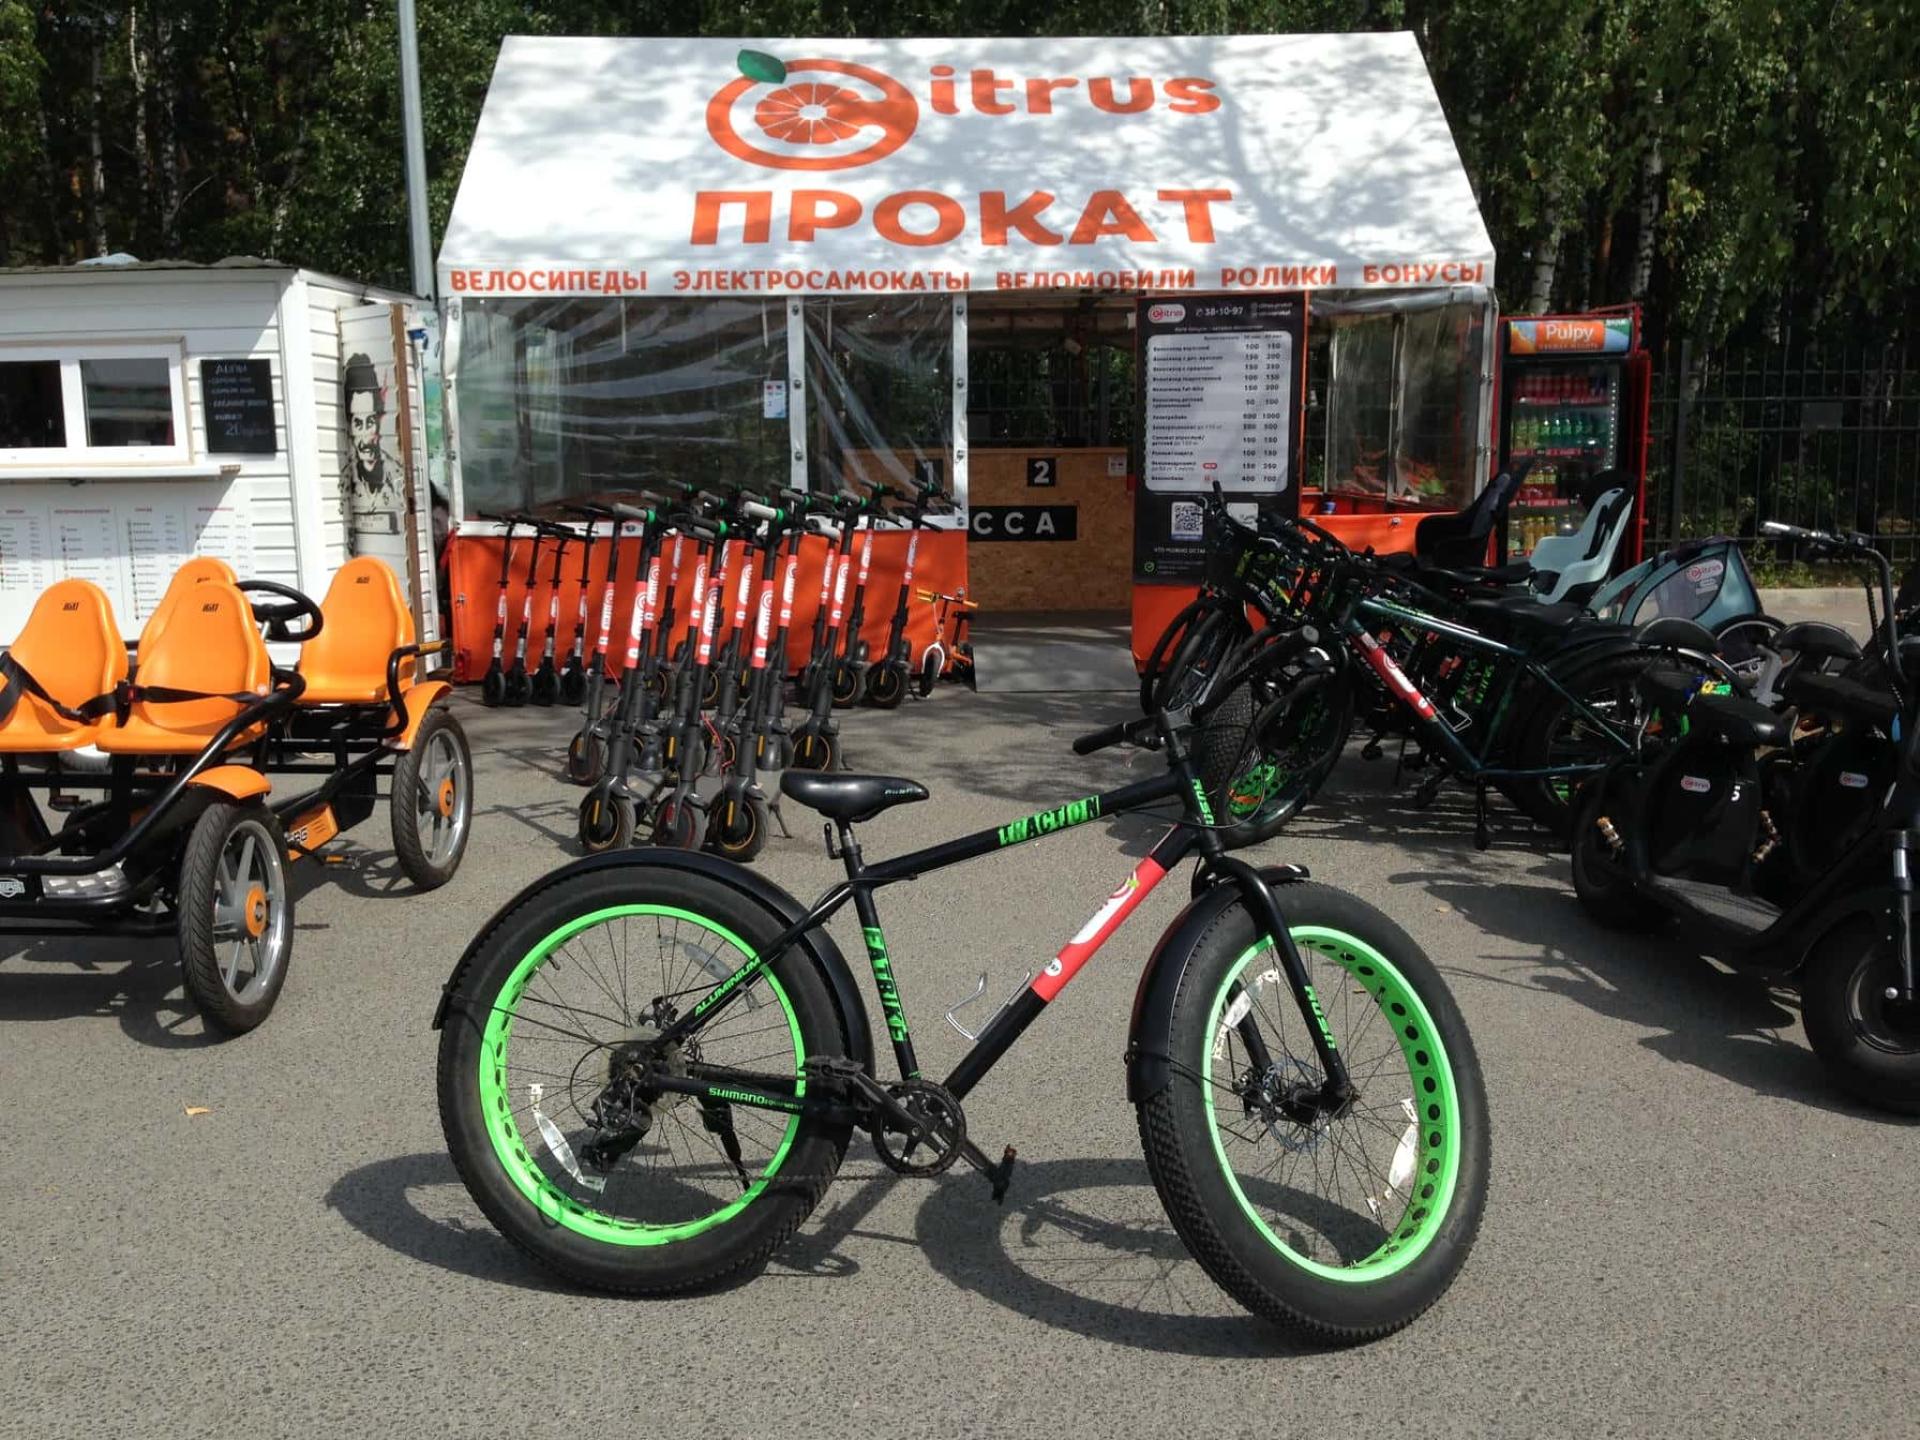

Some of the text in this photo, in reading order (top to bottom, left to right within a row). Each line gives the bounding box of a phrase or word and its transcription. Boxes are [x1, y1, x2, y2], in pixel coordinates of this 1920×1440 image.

[691, 189, 1232, 247] ПРОКАТ
[451, 262, 1483, 293] ВЕЛОСИПЕДЫ ЭЛЕКТРОСАМОКАТЫ ВЕЛОМОБИЛИ РОЛИКИ БОНУСЫ
[1546, 323, 1594, 342] Pulpy
[1034, 461, 1049, 483] 2
[998, 795, 1102, 846] TRACTION
[695, 956, 761, 1017] ALUMINIUM
[863, 927, 908, 1041] FATBIKE
[708, 1087, 765, 1105] SHIMANO
